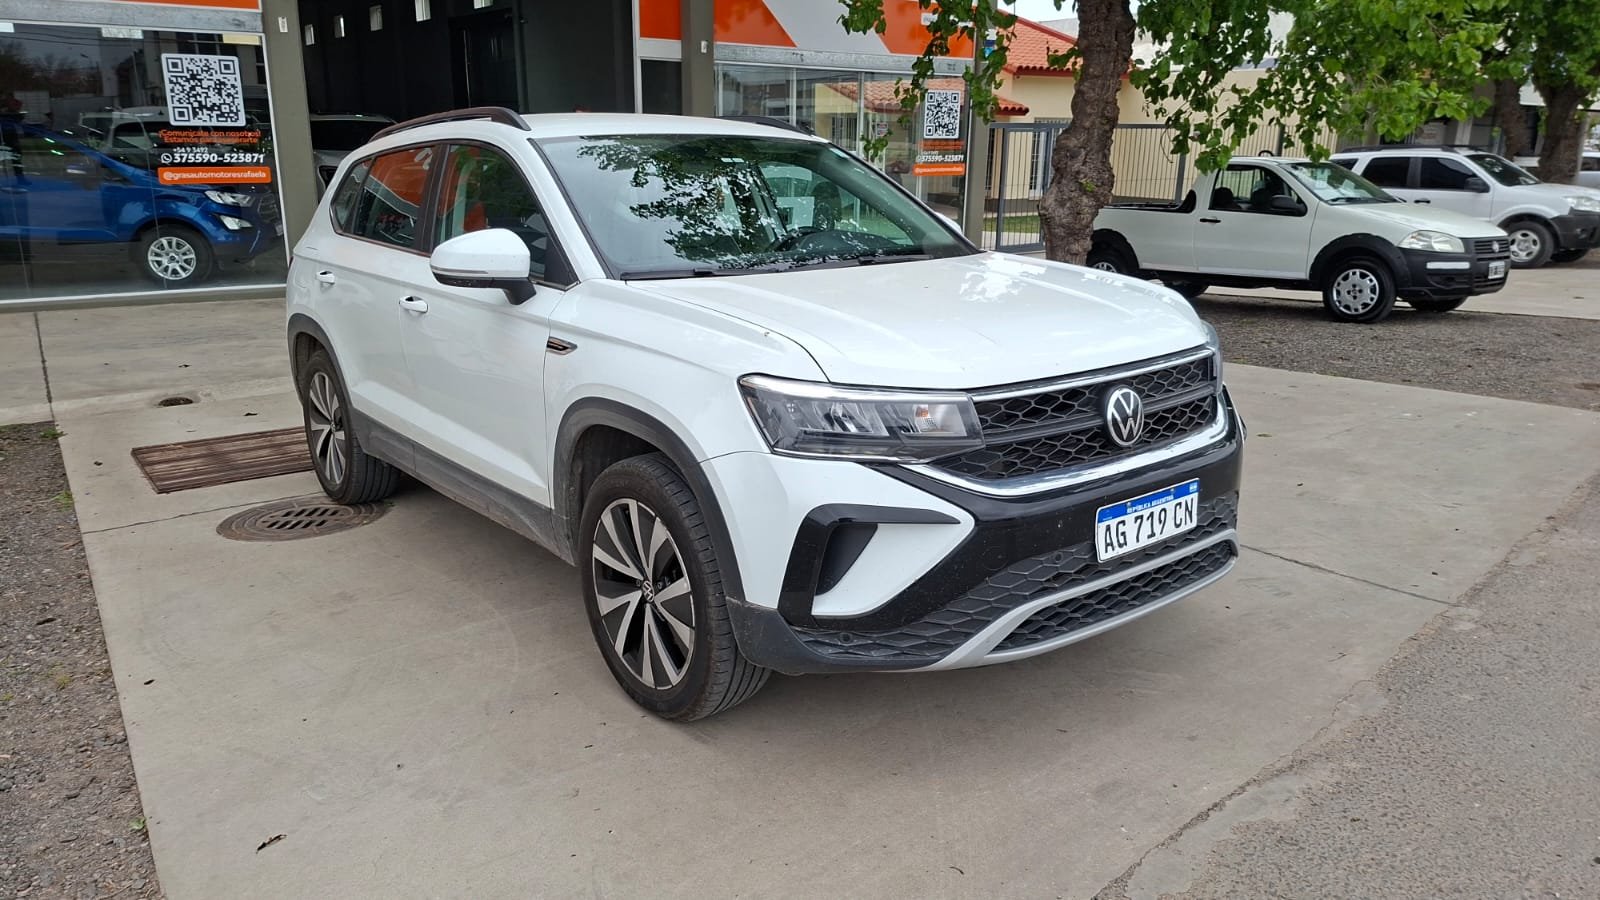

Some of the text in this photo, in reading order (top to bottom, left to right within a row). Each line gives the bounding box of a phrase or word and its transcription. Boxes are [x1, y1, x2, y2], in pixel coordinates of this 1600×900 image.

[210, 129, 225, 137] con
[173, 153, 264, 163] 375590-523871
[163, 170, 266, 180] @grasautomotoresrafaela
[1104, 497, 1194, 554] AG 719 CN
